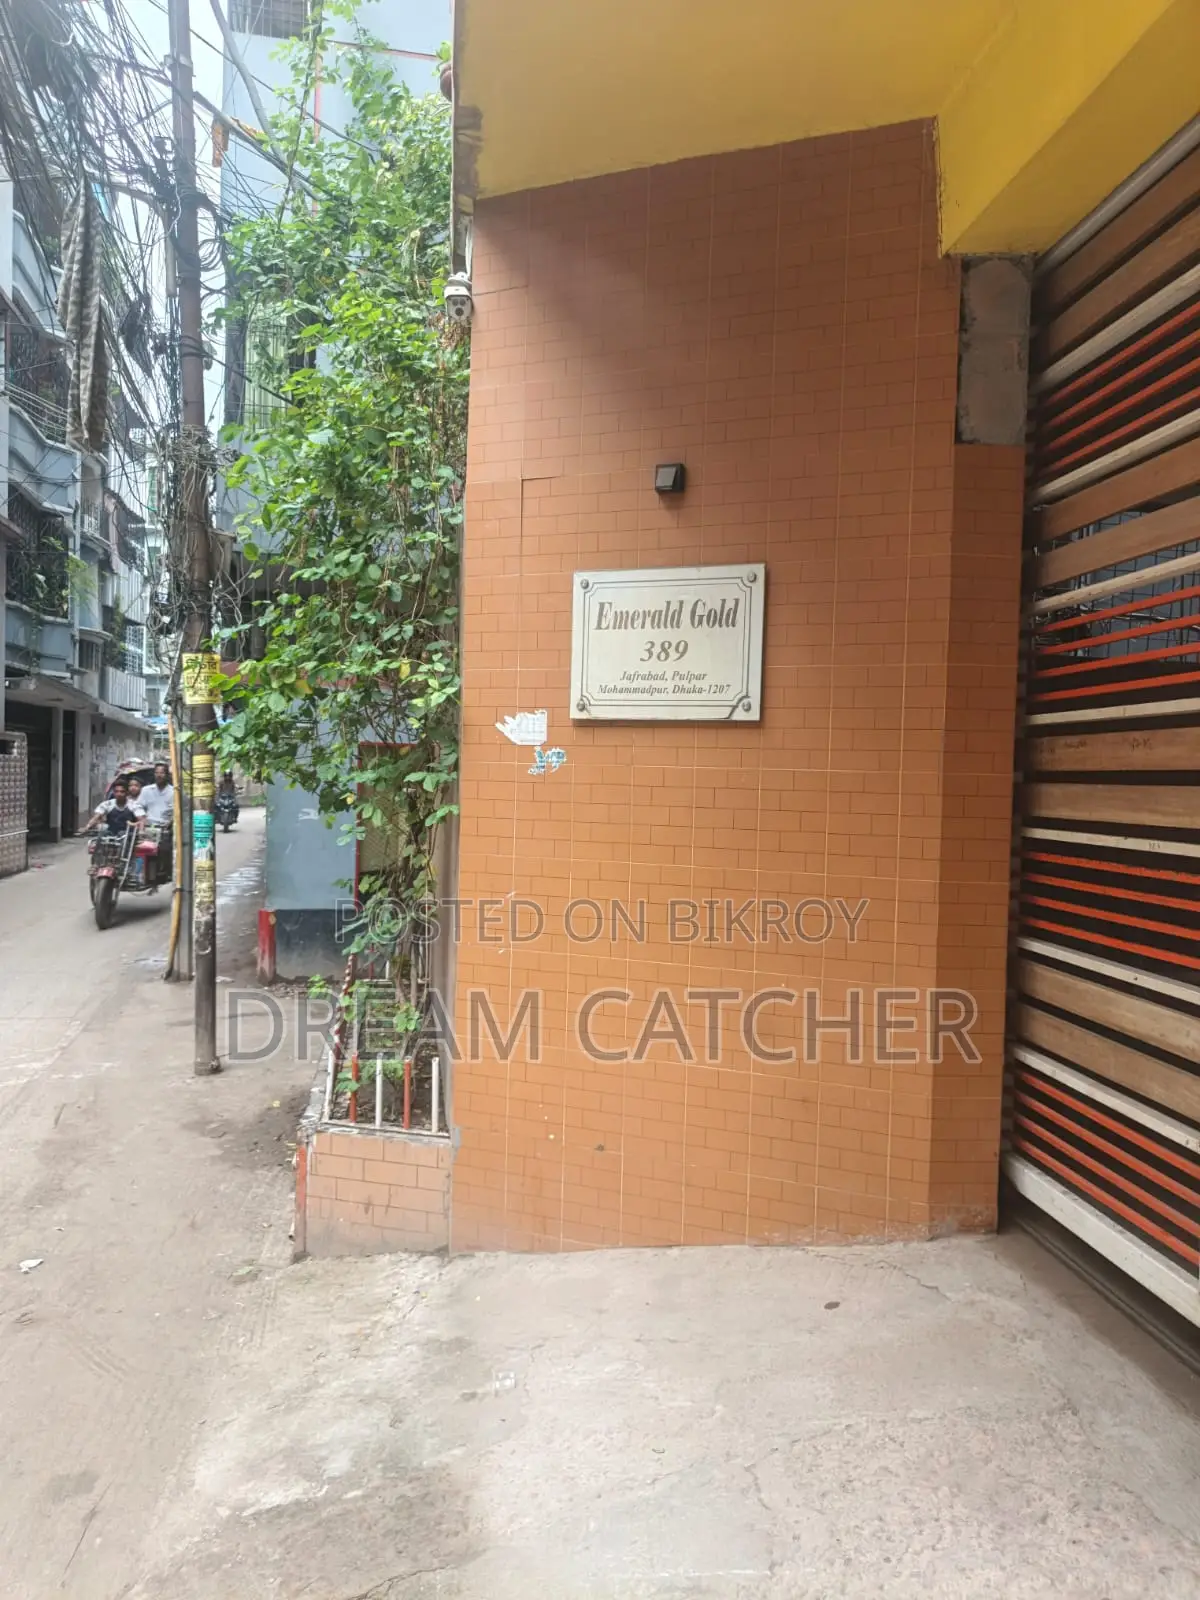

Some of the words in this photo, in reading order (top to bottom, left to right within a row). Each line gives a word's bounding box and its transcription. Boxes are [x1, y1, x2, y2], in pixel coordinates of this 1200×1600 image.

[595, 600, 684, 630] Emerald
[690, 598, 740, 629] Gold
[640, 640, 688, 662] 389
[620, 670, 668, 684] Jafrabad,
[672, 670, 707, 684] Pulpar
[672, 684, 731, 695] Dhaka-1207
